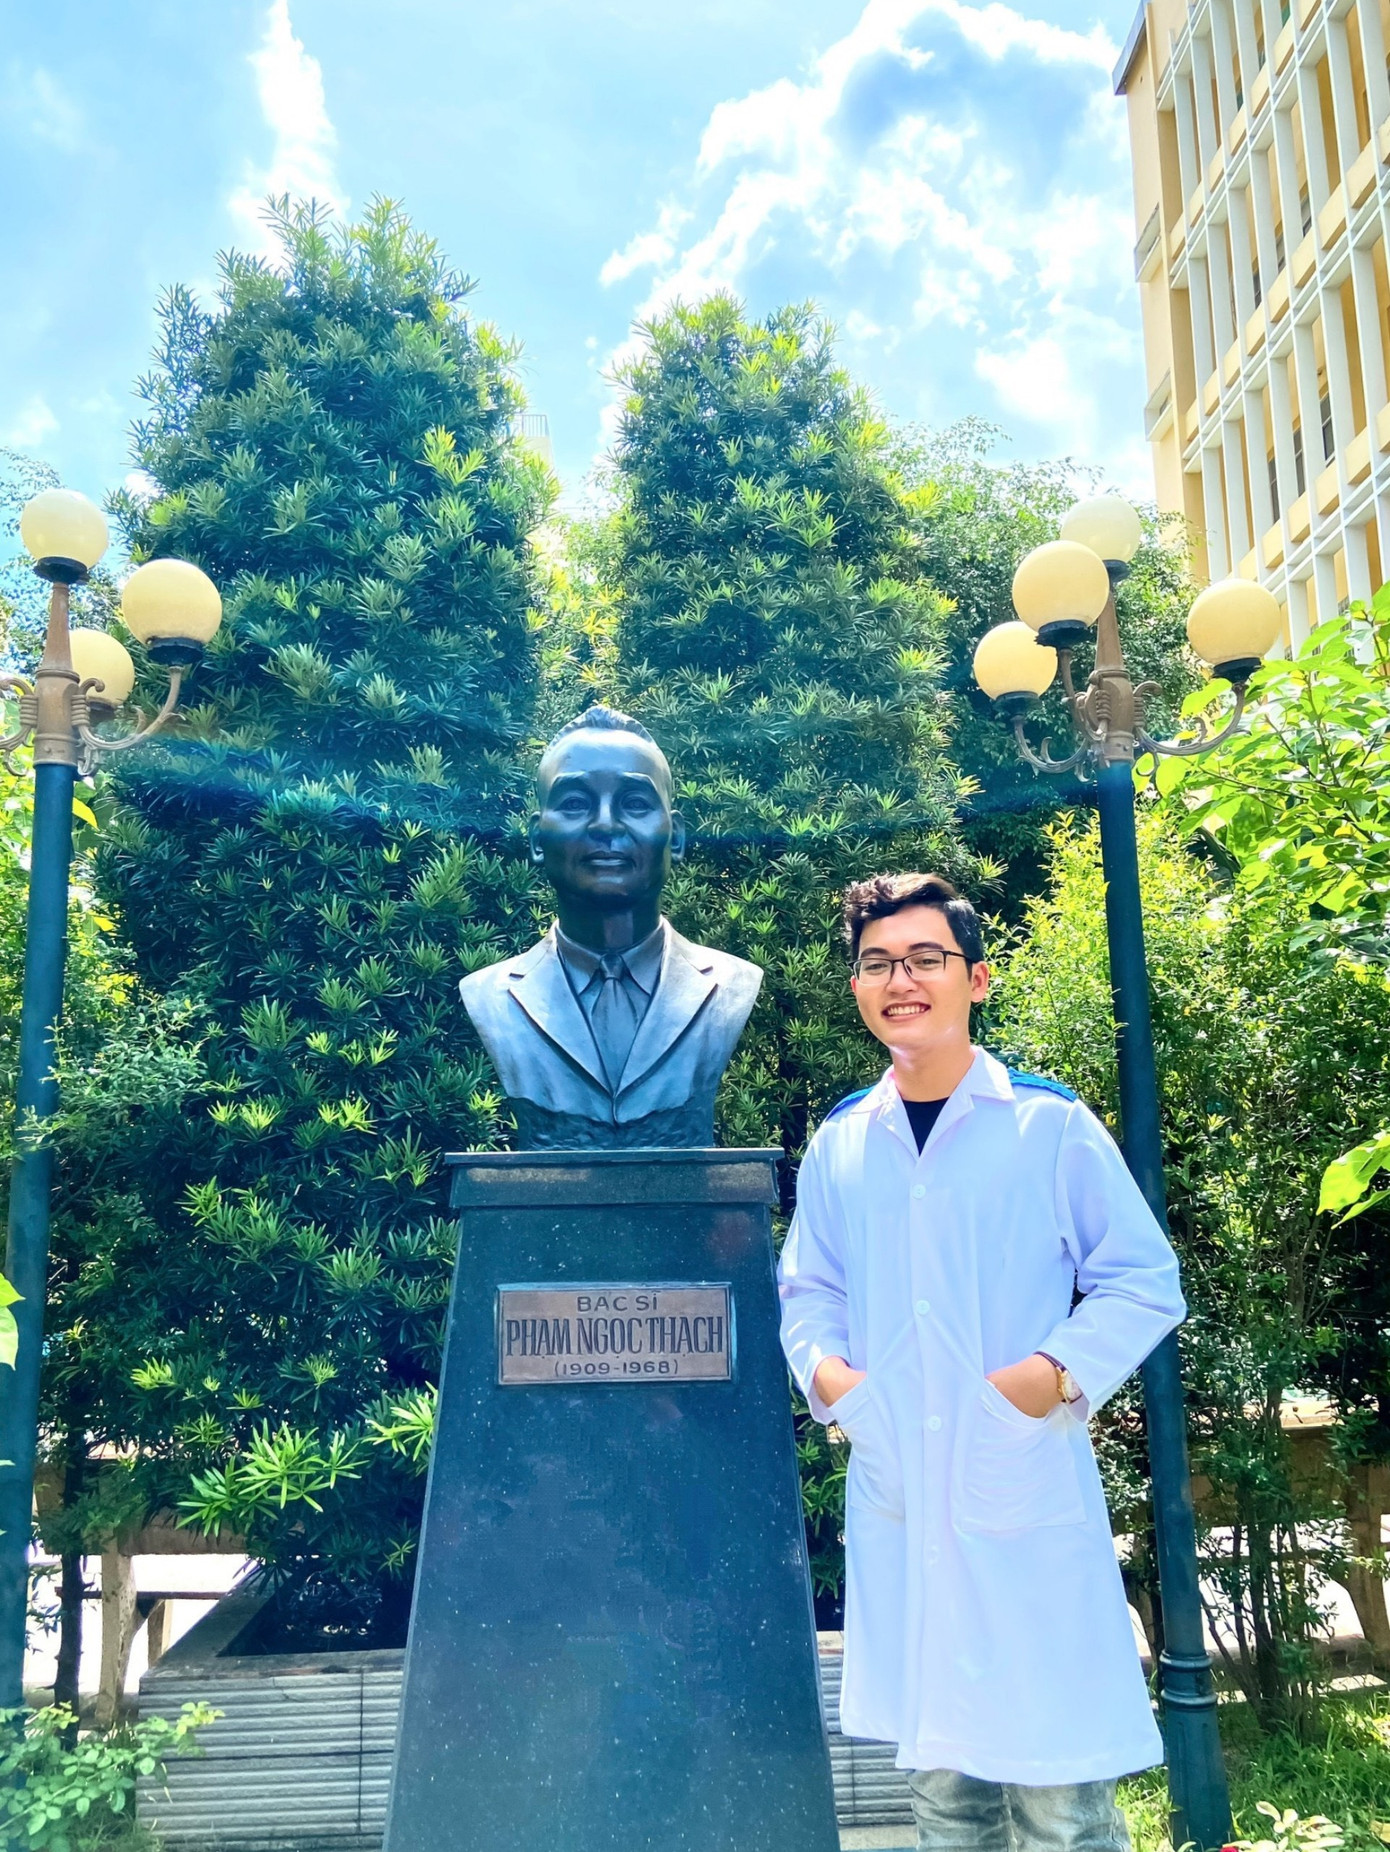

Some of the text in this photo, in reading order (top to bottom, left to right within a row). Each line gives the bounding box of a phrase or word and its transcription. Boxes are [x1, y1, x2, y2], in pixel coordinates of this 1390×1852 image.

[505, 1316, 723, 1358] PHẠM NGỌC THẠCH
[554, 1359, 679, 1377] (1909-1968)
